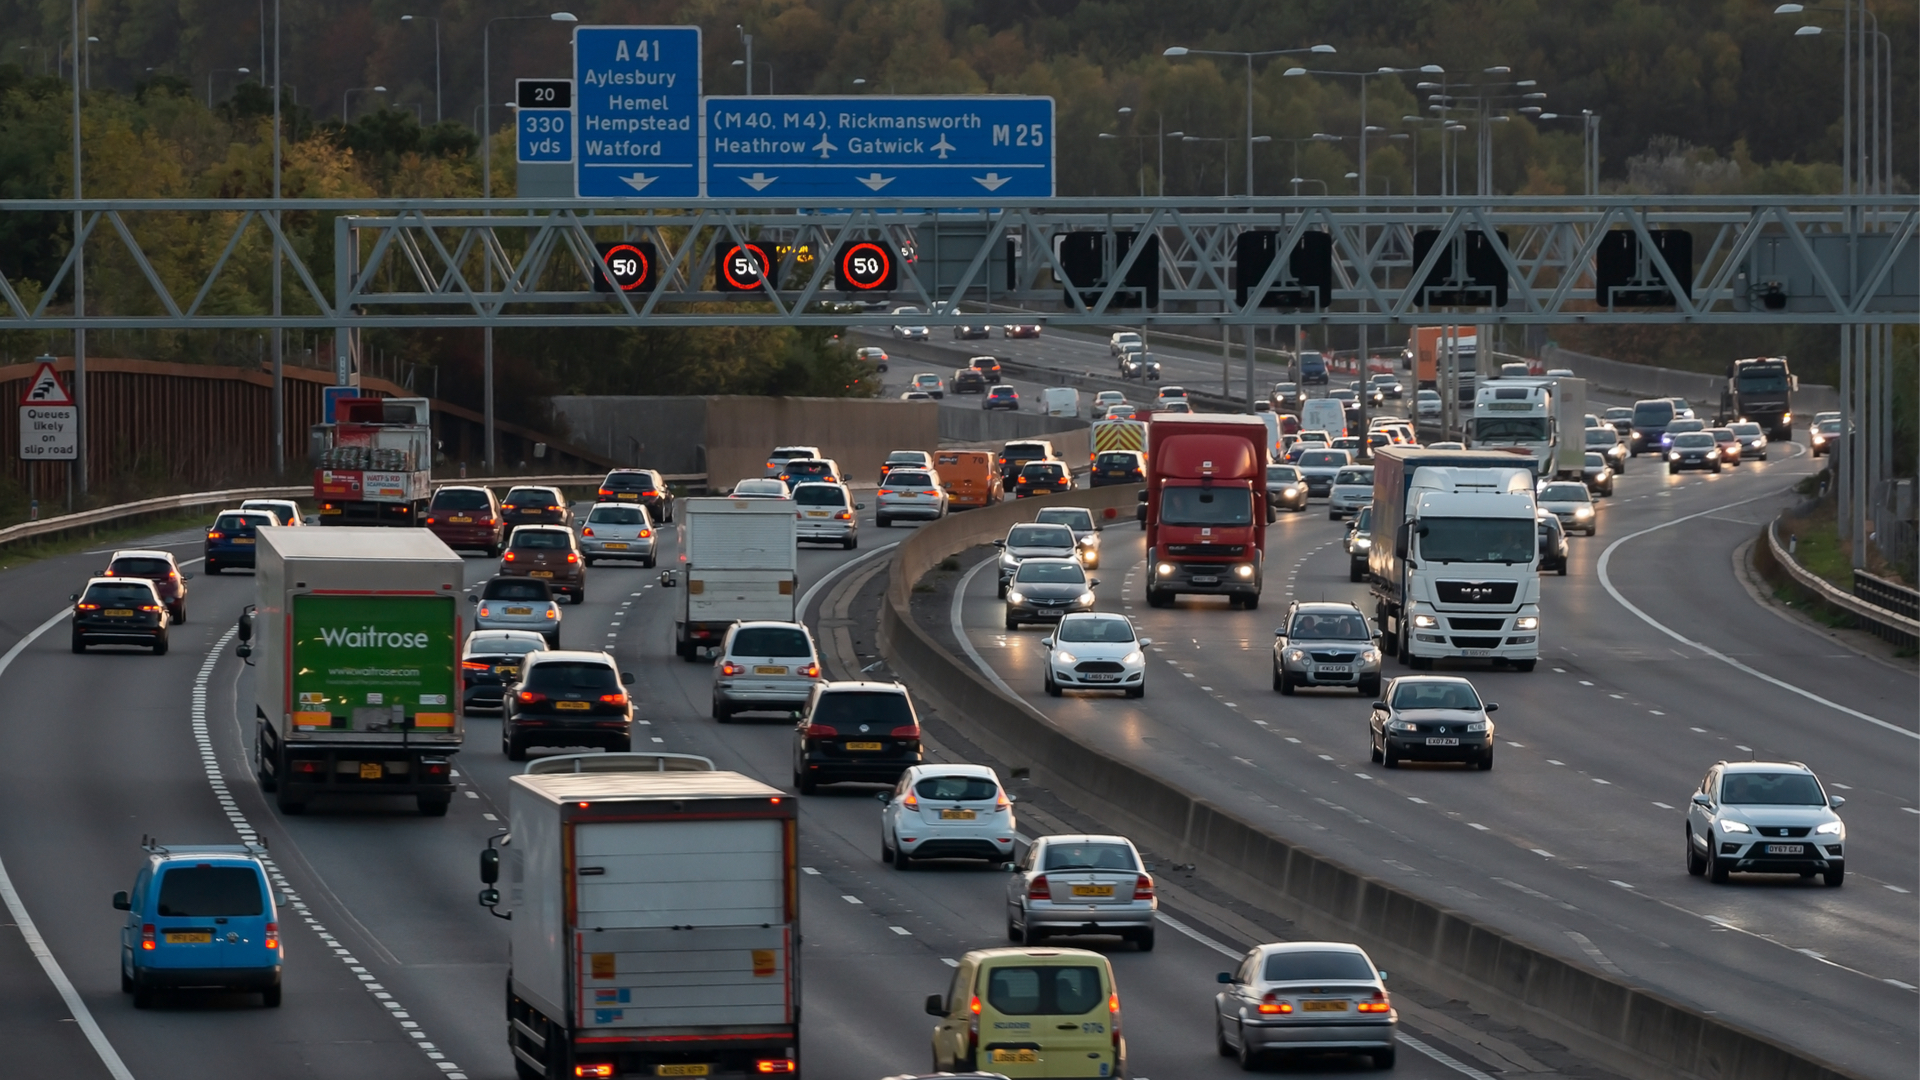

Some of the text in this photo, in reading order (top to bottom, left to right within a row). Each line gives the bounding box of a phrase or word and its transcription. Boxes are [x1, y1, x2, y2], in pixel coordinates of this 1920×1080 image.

[584, 68, 676, 88] Aylesbury
[535, 88, 555, 101] 20
[609, 94, 669, 110] Hemel
[526, 116, 564, 133] 330
[586, 114, 690, 133] Hempstead
[839, 112, 981, 129] Rickmansworth
[529, 137, 561, 156] yds
[585, 139, 661, 156] Watford
[715, 137, 924, 153] Heathrow Gatwick
[613, 259, 637, 276] 50
[735, 258, 758, 275] 50
[854, 257, 879, 274] 50
[28, 409, 70, 420] Queues
[33, 421, 64, 432] likely
[42, 434, 56, 442] on
[24, 445, 73, 455] slip road
[973, 456, 984, 464] 70
[320, 625, 429, 648] Waitrose
[1082, 1022, 1105, 1034] 976
